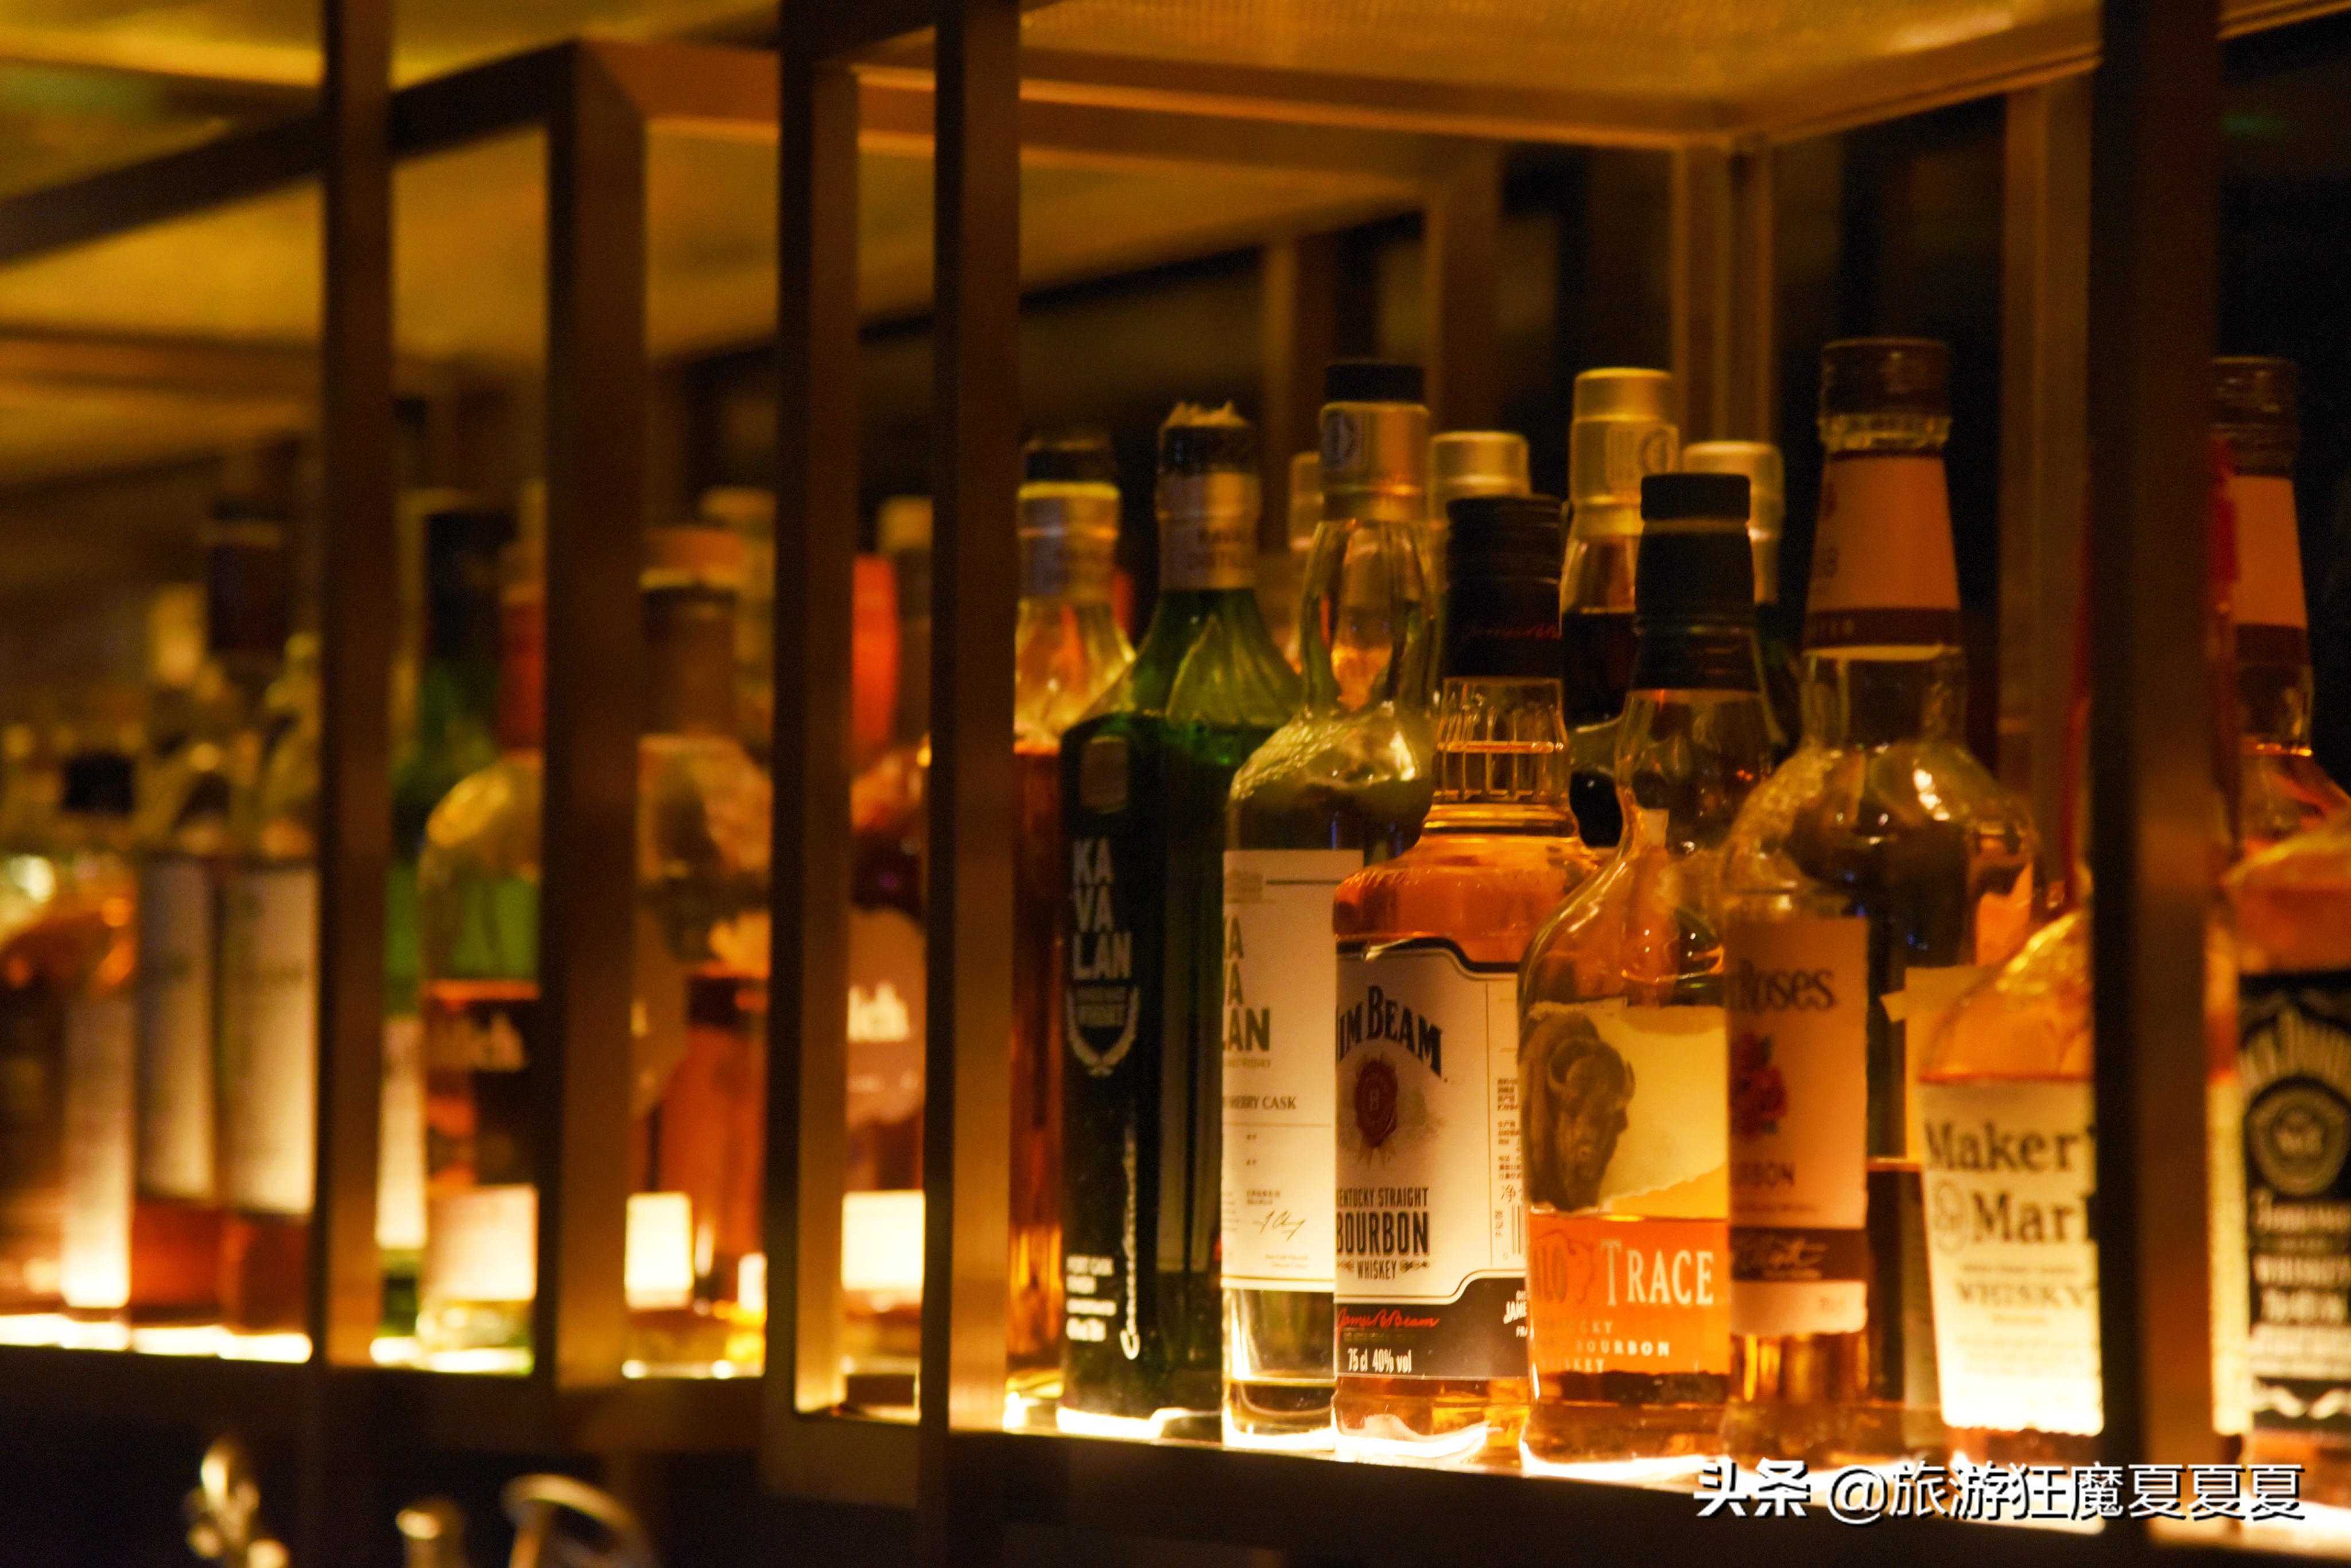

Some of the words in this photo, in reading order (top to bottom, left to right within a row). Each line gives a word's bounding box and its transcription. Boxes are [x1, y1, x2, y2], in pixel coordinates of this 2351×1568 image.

[1072, 837, 1114, 885] KA
[1073, 886, 1114, 932] VA
[1073, 931, 1132, 980] LAN
[1223, 1008, 1271, 1051] AN
[1336, 1002, 1363, 1062] IM
[1368, 985, 1442, 1078] BEAM
[1262, 1095, 1297, 1110] CASK
[1378, 1186, 1429, 1208] STRAIGHT
[1336, 1211, 1430, 1256] BOURBON
[1357, 1260, 1397, 1280] WHISKEY
[1600, 1238, 1714, 1307] TRACE
[1372, 1348, 1395, 1373] 40%
[1396, 1349, 1412, 1373] vol
